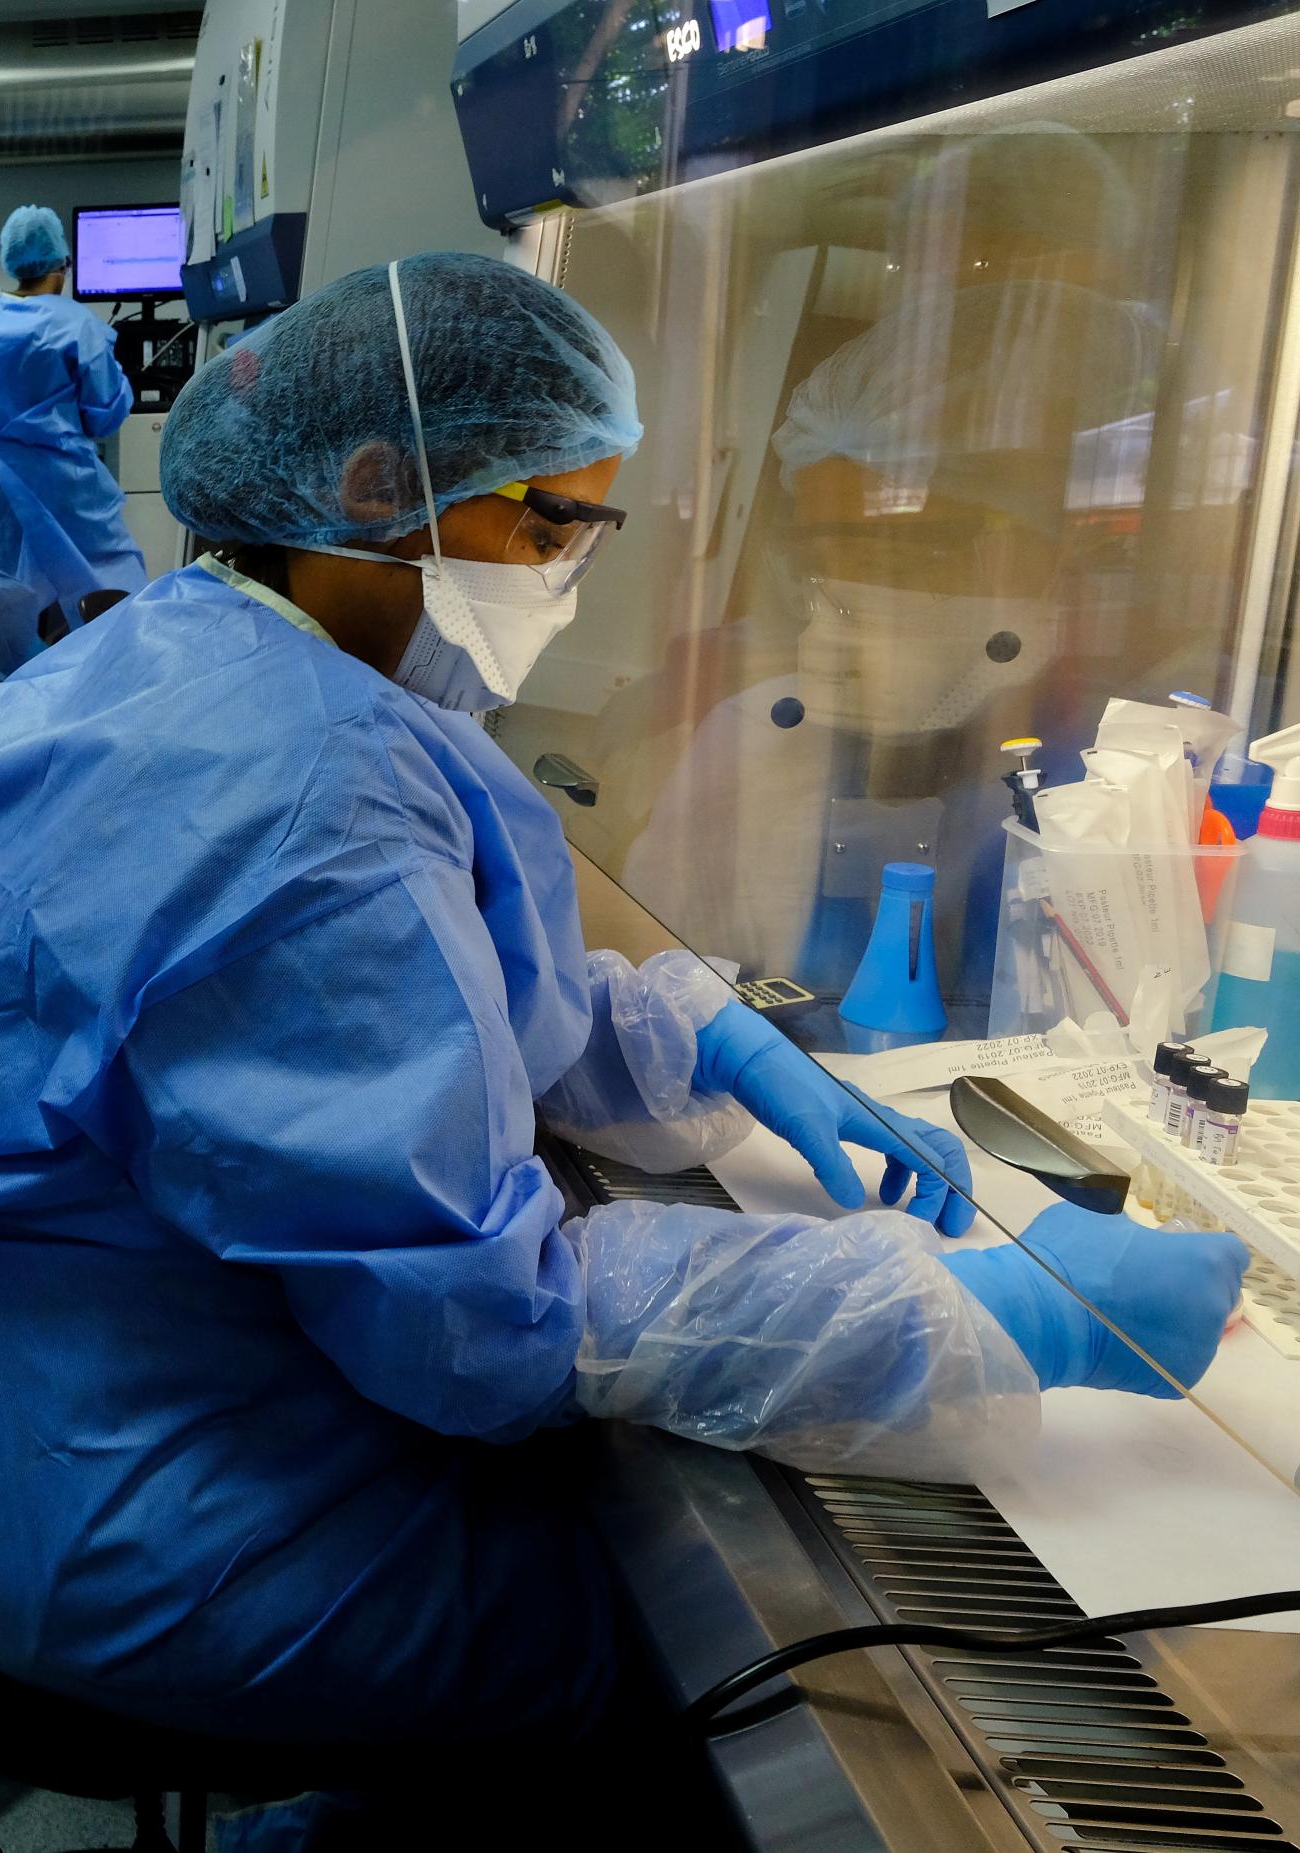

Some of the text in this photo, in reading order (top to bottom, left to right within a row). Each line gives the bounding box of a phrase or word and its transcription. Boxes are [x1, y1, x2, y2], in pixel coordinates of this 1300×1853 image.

[1099, 889, 1111, 921] Pasteur
[1107, 923, 1118, 953] Pipette
[948, 1049, 1053, 1074] Pasteur Pipette 1ml
[1106, 1082, 1137, 1094] Pasteur
[1059, 1120, 1102, 1131] MFG:0
